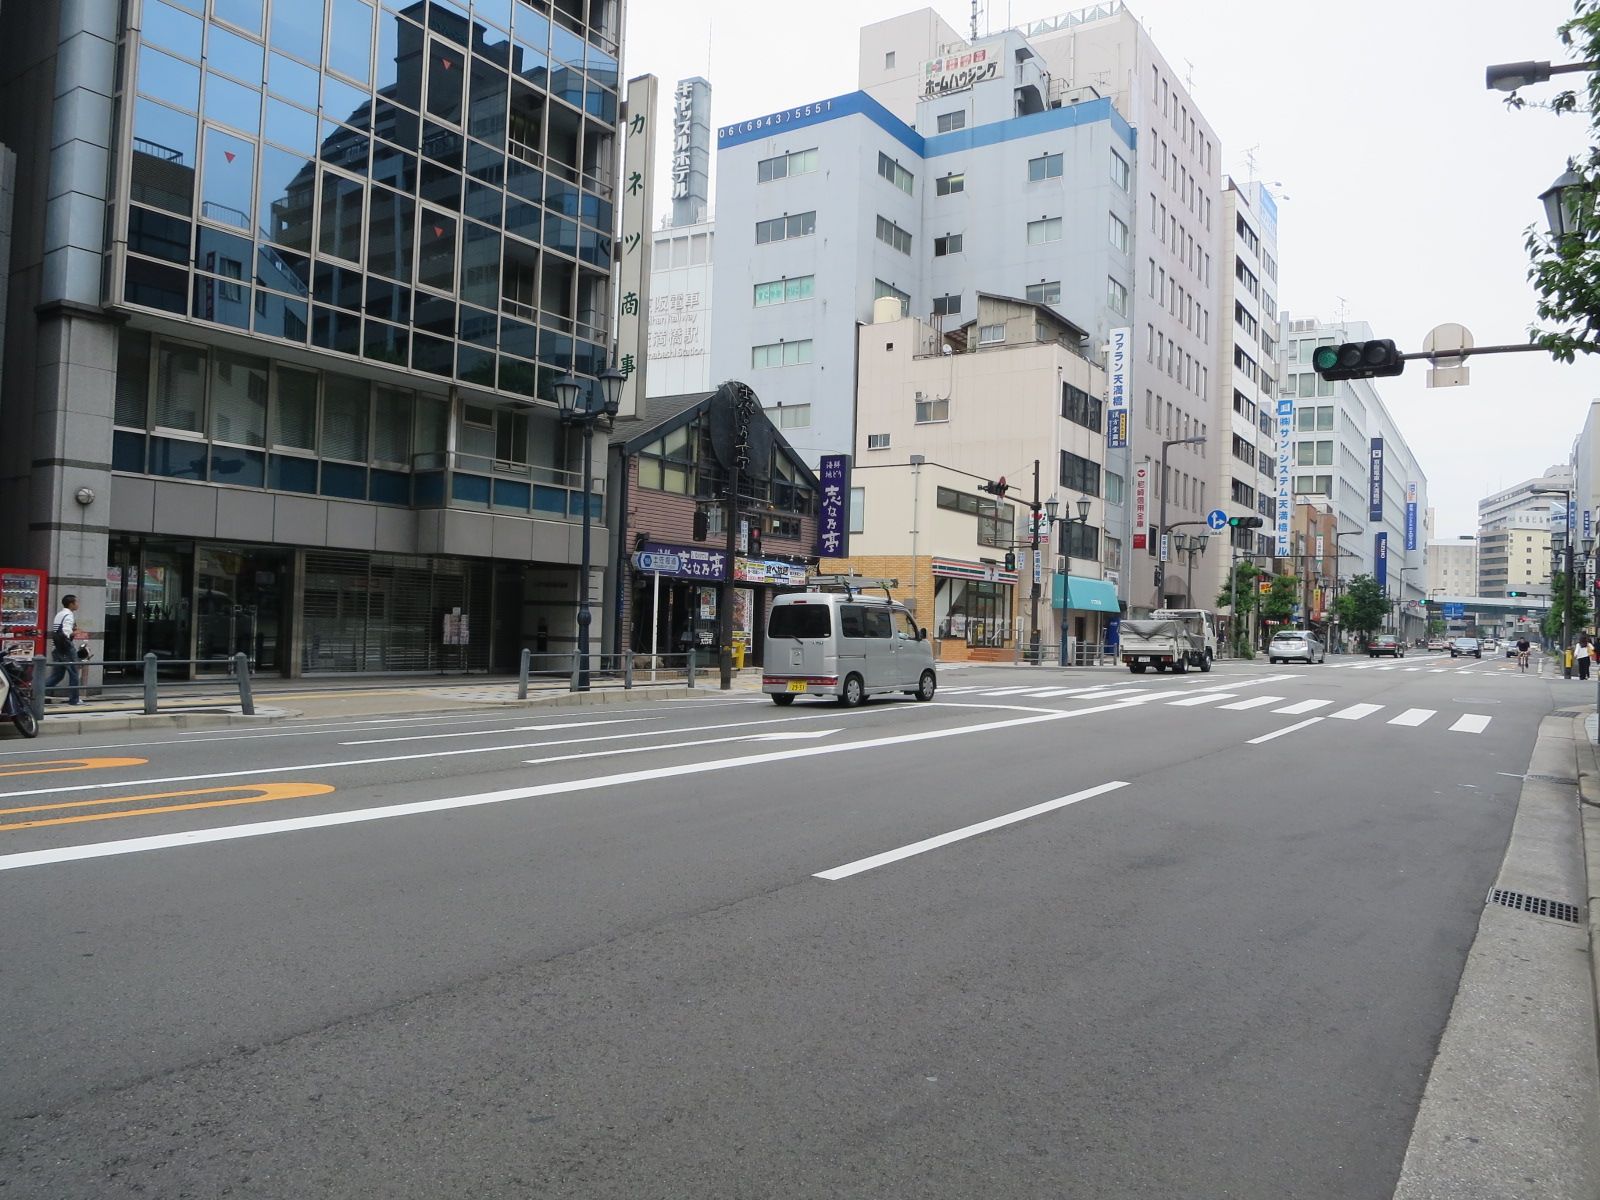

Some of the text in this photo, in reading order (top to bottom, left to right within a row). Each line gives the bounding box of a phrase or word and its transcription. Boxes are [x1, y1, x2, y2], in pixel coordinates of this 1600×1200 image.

[925, 61, 998, 95] ホームハウジング
[673, 82, 693, 199] キャッスルホテル
[719, 101, 832, 138] 06(6943)5551
[618, 113, 646, 378] カネツ商事
[1113, 333, 1124, 407] ファラン天満橋
[826, 461, 841, 469] 海鮮
[822, 484, 842, 553] 志な乃亭
